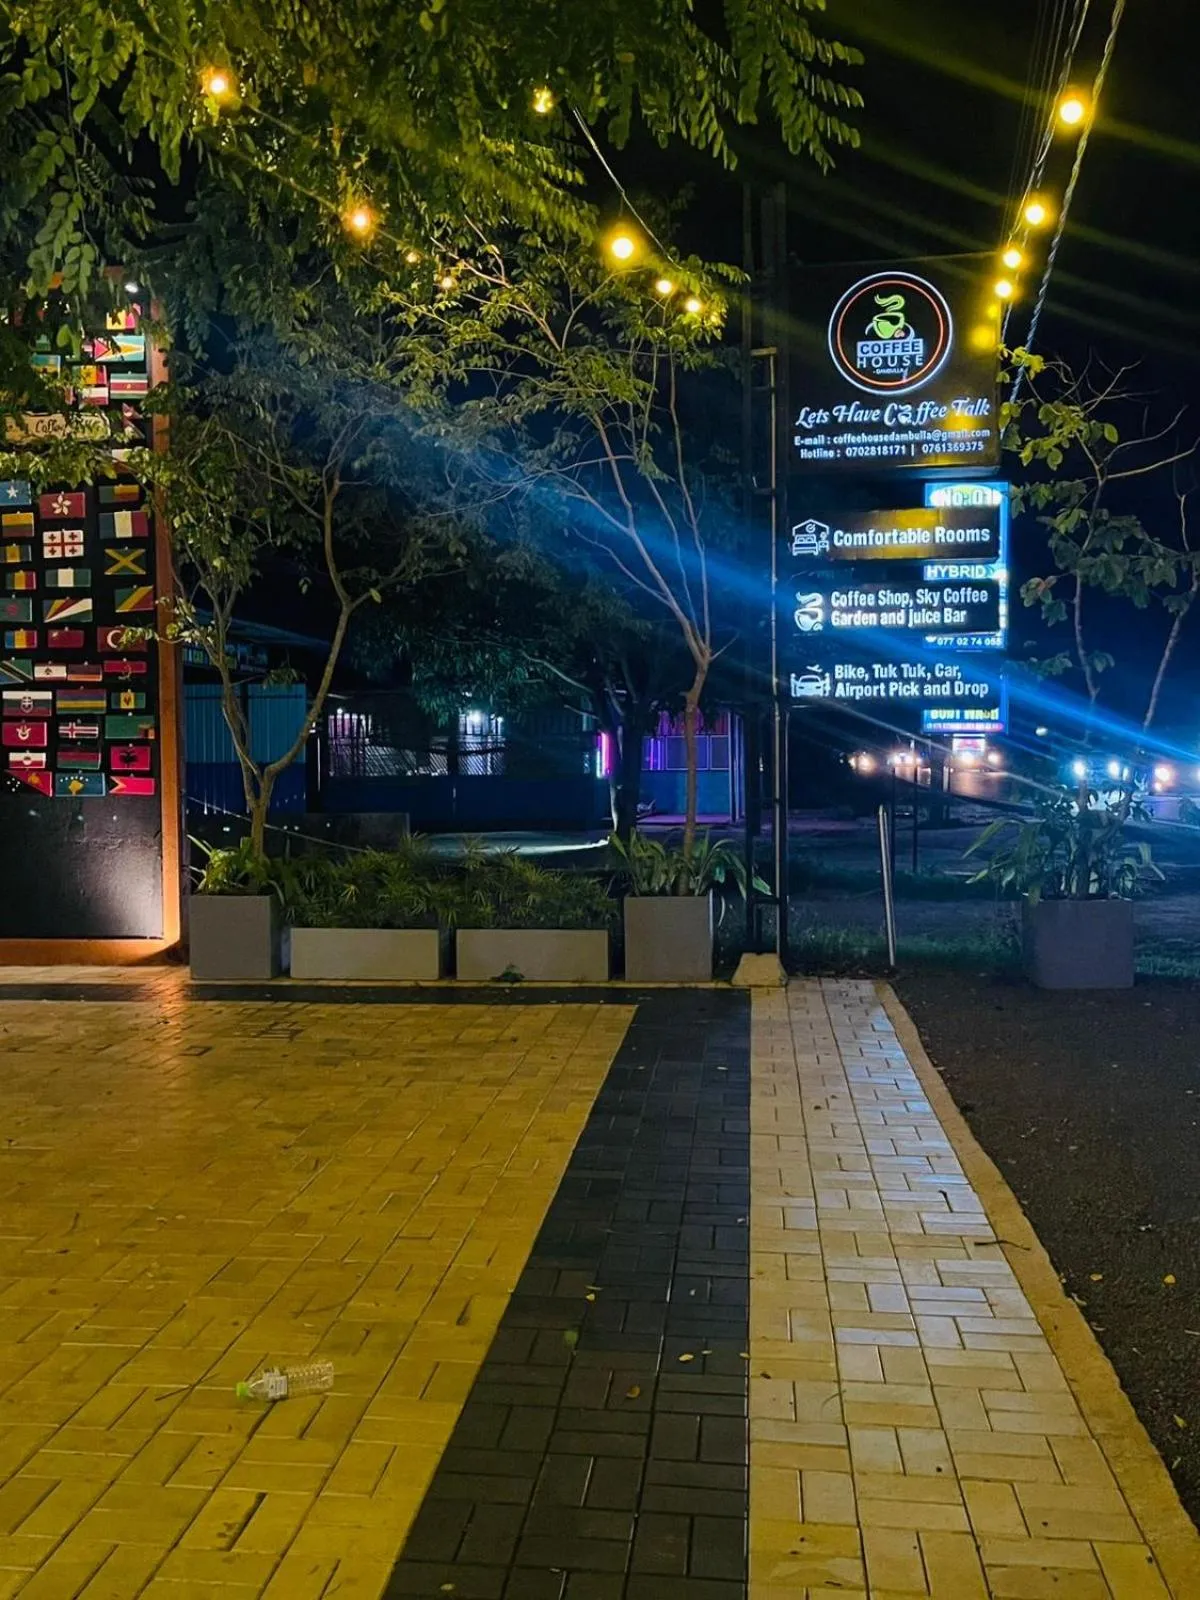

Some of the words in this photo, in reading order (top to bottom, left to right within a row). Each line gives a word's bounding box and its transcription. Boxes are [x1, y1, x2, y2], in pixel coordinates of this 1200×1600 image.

[860, 341, 920, 355] COFFEE
[857, 355, 923, 368] HOUSE
[795, 406, 829, 429] Lets
[832, 401, 880, 424] Have
[951, 398, 991, 418] Talk
[794, 435, 825, 446] E-mail
[800, 448, 835, 460] Hotline
[845, 445, 906, 458] 0702818171
[833, 528, 931, 547] Comfortable
[934, 526, 991, 543] Rooms
[926, 565, 986, 579] HYBRID
[831, 590, 876, 607] Coffee
[878, 589, 913, 609] Shop,
[916, 588, 941, 607] Sky
[943, 587, 989, 604] Coffee
[831, 609, 878, 627] Garden
[880, 609, 906, 625] and
[908, 607, 940, 628] juice
[943, 607, 967, 623] Bar
[937, 636, 954, 646] 077
[956, 637, 969, 646] 02
[970, 637, 983, 645] 74
[834, 664, 869, 680] Bike,
[872, 664, 897, 678] Tuk
[900, 664, 931, 680] Tuk,
[934, 663, 962, 679] Car,
[834, 682, 886, 700] Airport
[889, 682, 920, 696] Pick
[923, 681, 950, 696] and
[954, 681, 989, 698] Drop
